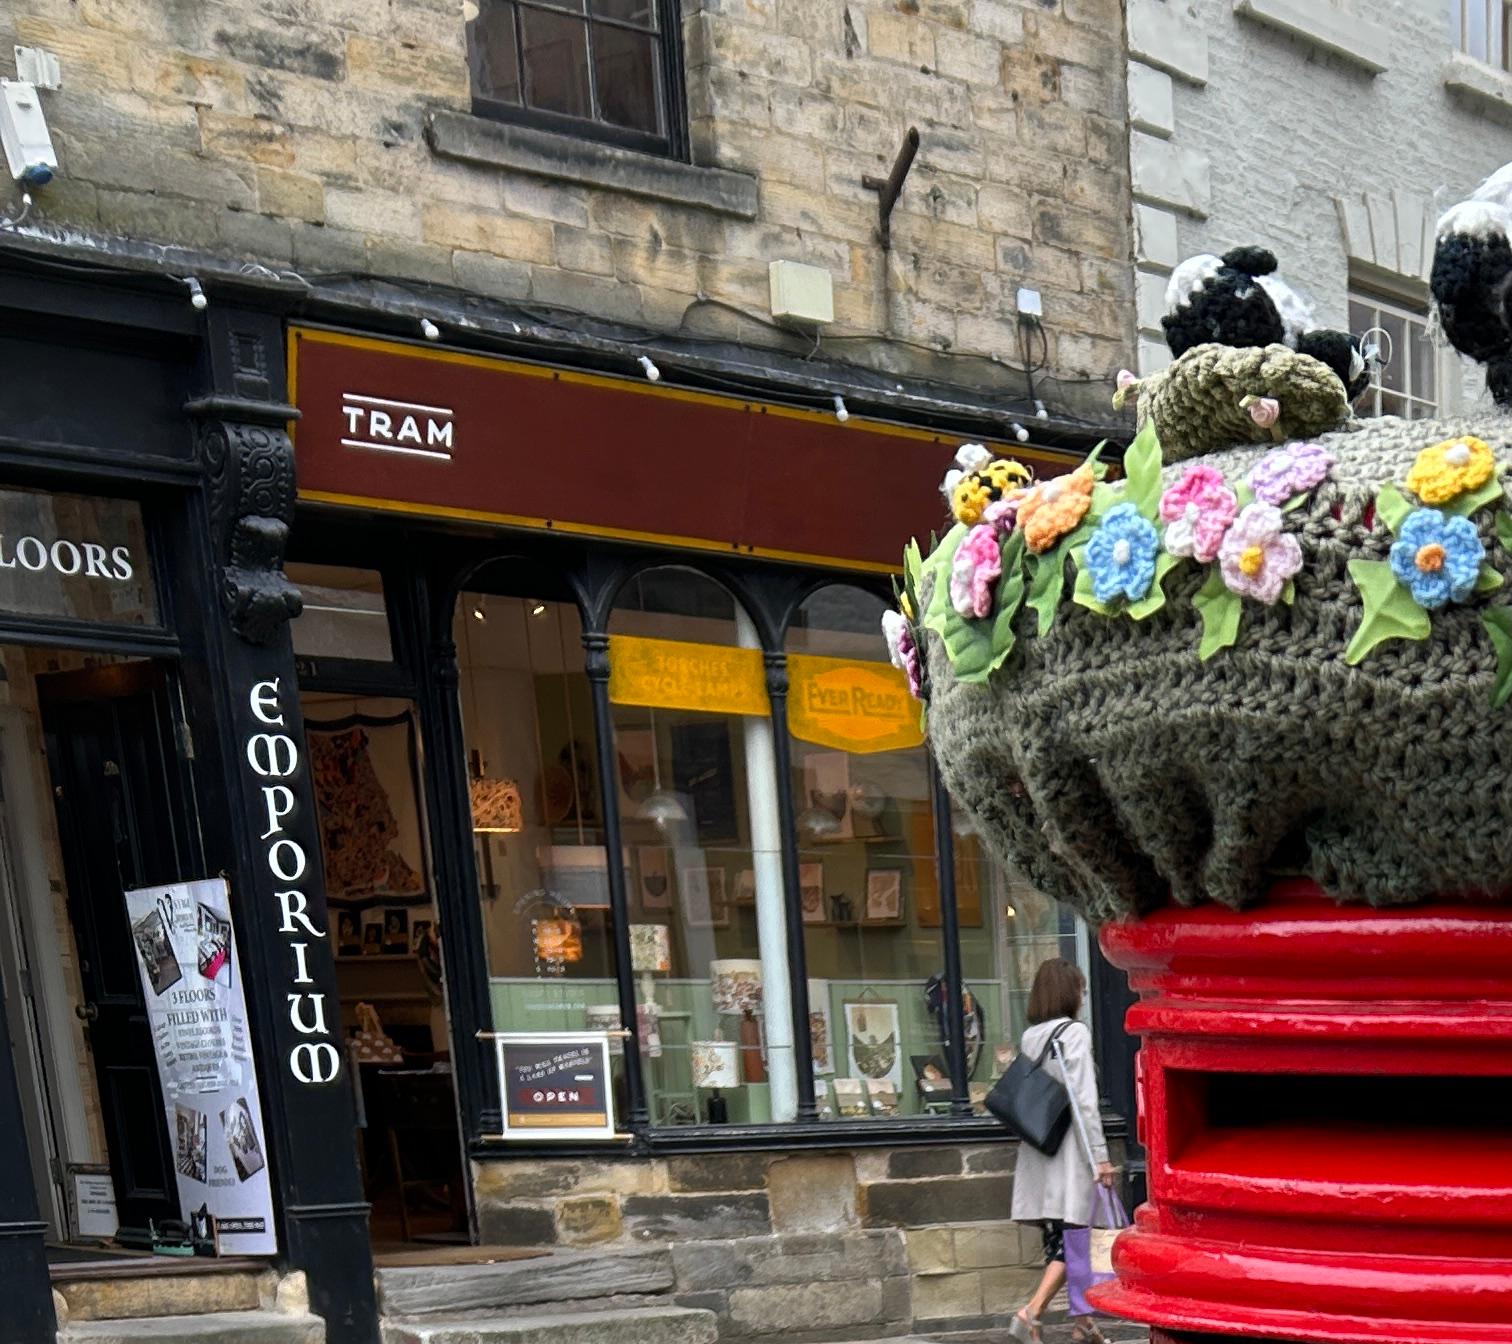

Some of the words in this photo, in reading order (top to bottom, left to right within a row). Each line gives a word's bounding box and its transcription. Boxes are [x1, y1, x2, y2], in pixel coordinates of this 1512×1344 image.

[343, 405, 453, 447] TRAM
[0, 533, 133, 580] LOORS
[807, 681, 848, 712] EVER
[247, 677, 340, 1083] EMPORIUM
[172, 991, 179, 1005] 3
[179, 988, 216, 1004] FLOORS
[167, 1011, 199, 1027] FILLED
[200, 1007, 228, 1025] WITH
[533, 1091, 579, 1102] OPEN
